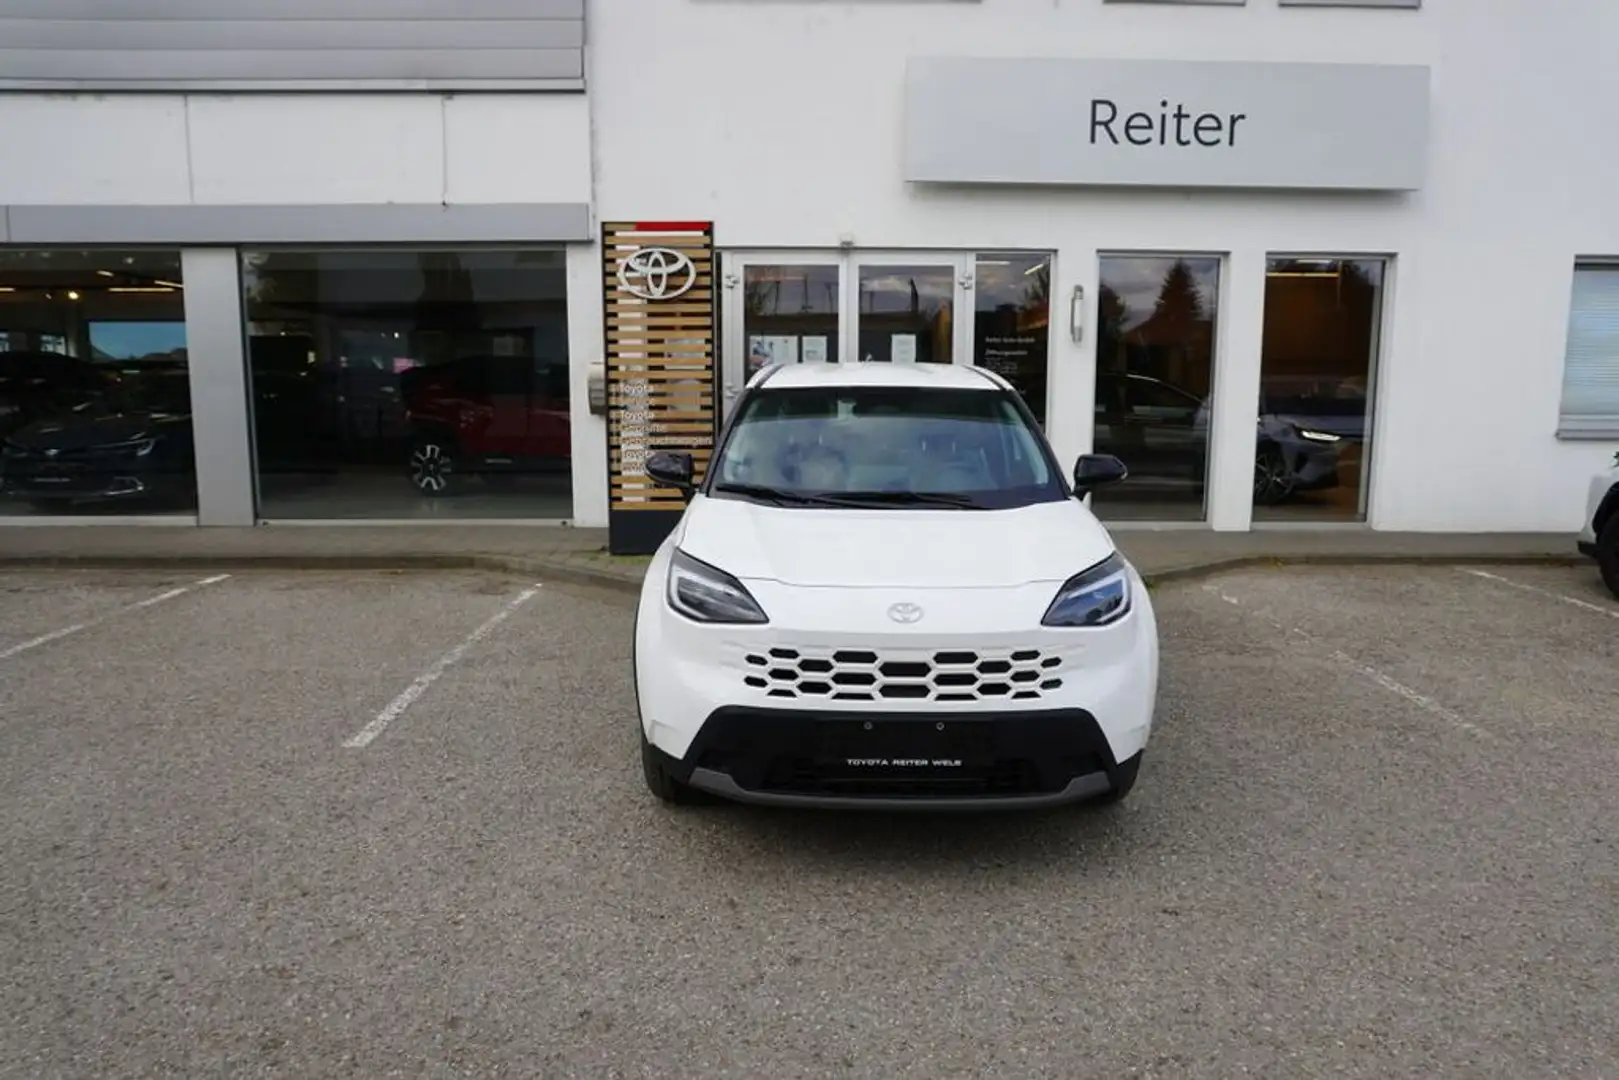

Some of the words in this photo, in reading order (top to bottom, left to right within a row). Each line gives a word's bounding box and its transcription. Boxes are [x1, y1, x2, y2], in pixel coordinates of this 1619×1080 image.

[1089, 99, 1247, 147] Reiter
[620, 383, 654, 395] Toyota
[621, 410, 655, 421] Toyota
[846, 758, 889, 767] TOYOTA
[892, 758, 928, 767] REITER
